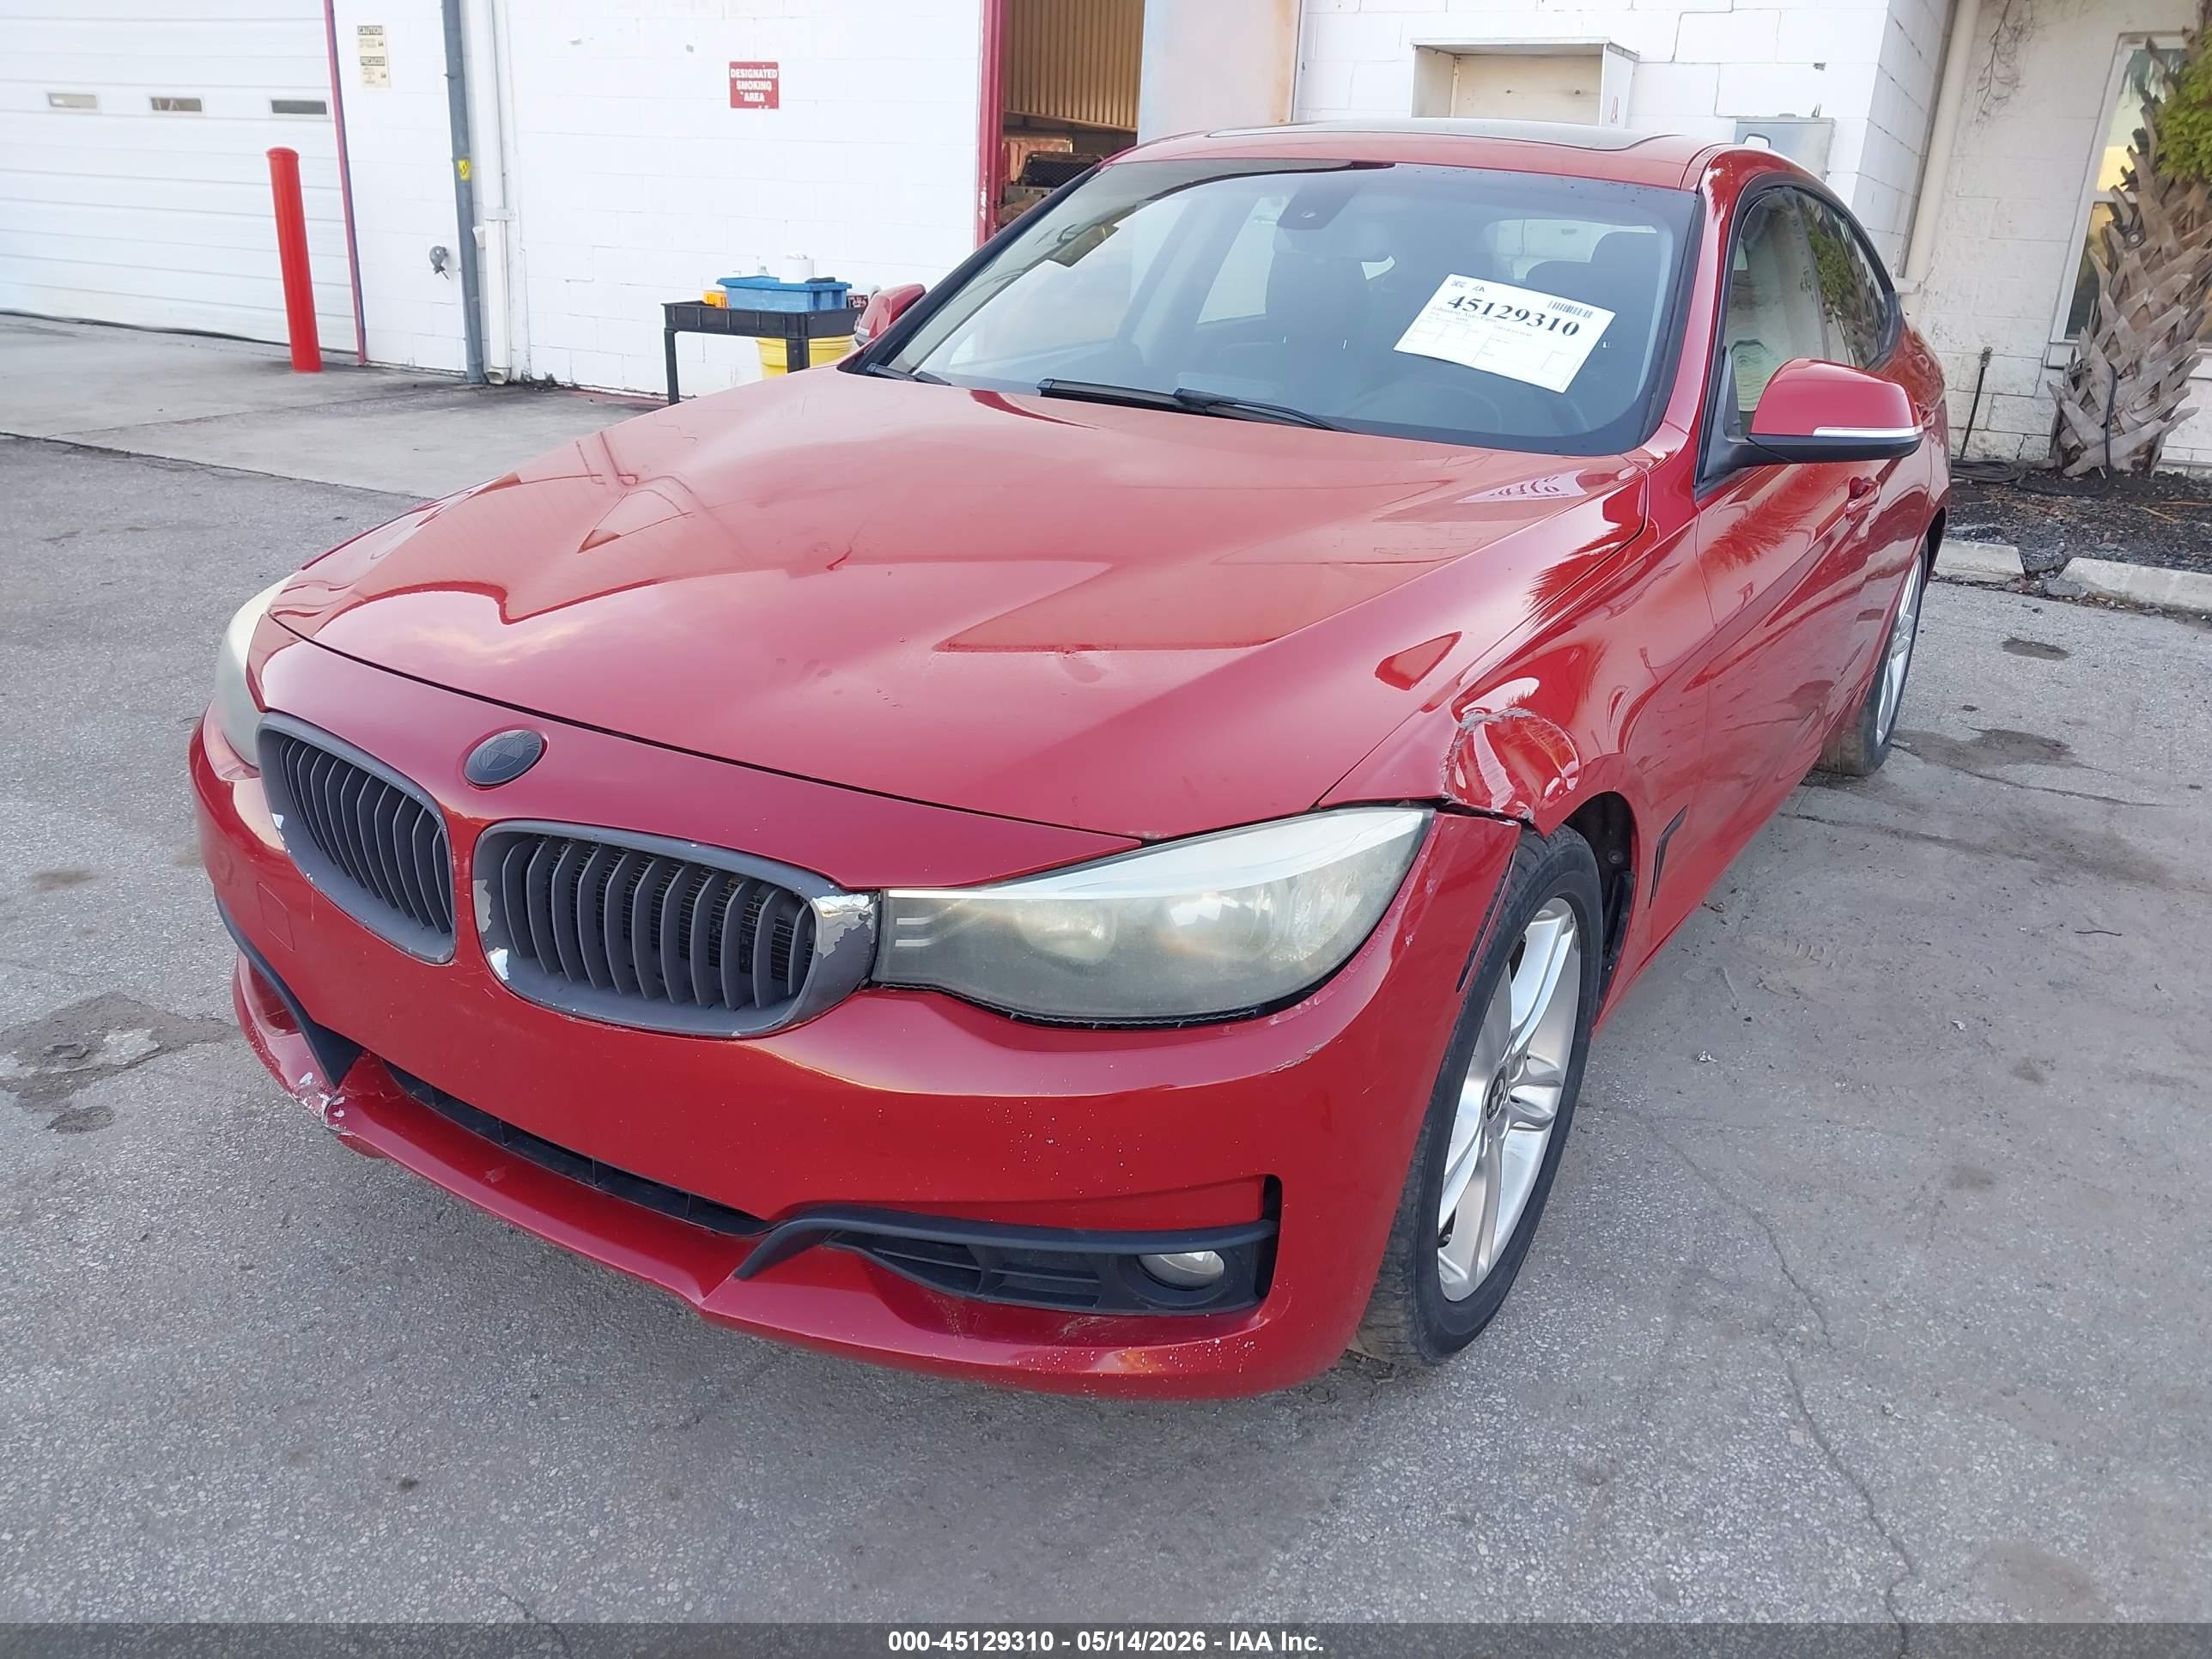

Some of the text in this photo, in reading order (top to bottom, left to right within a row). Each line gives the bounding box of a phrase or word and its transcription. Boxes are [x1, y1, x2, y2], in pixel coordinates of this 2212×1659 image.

[730, 68, 778, 79] DESIGNATED
[736, 80, 773, 91] SMOKING
[744, 92, 765, 102] AREA
[1447, 295, 1580, 337] 45129310
